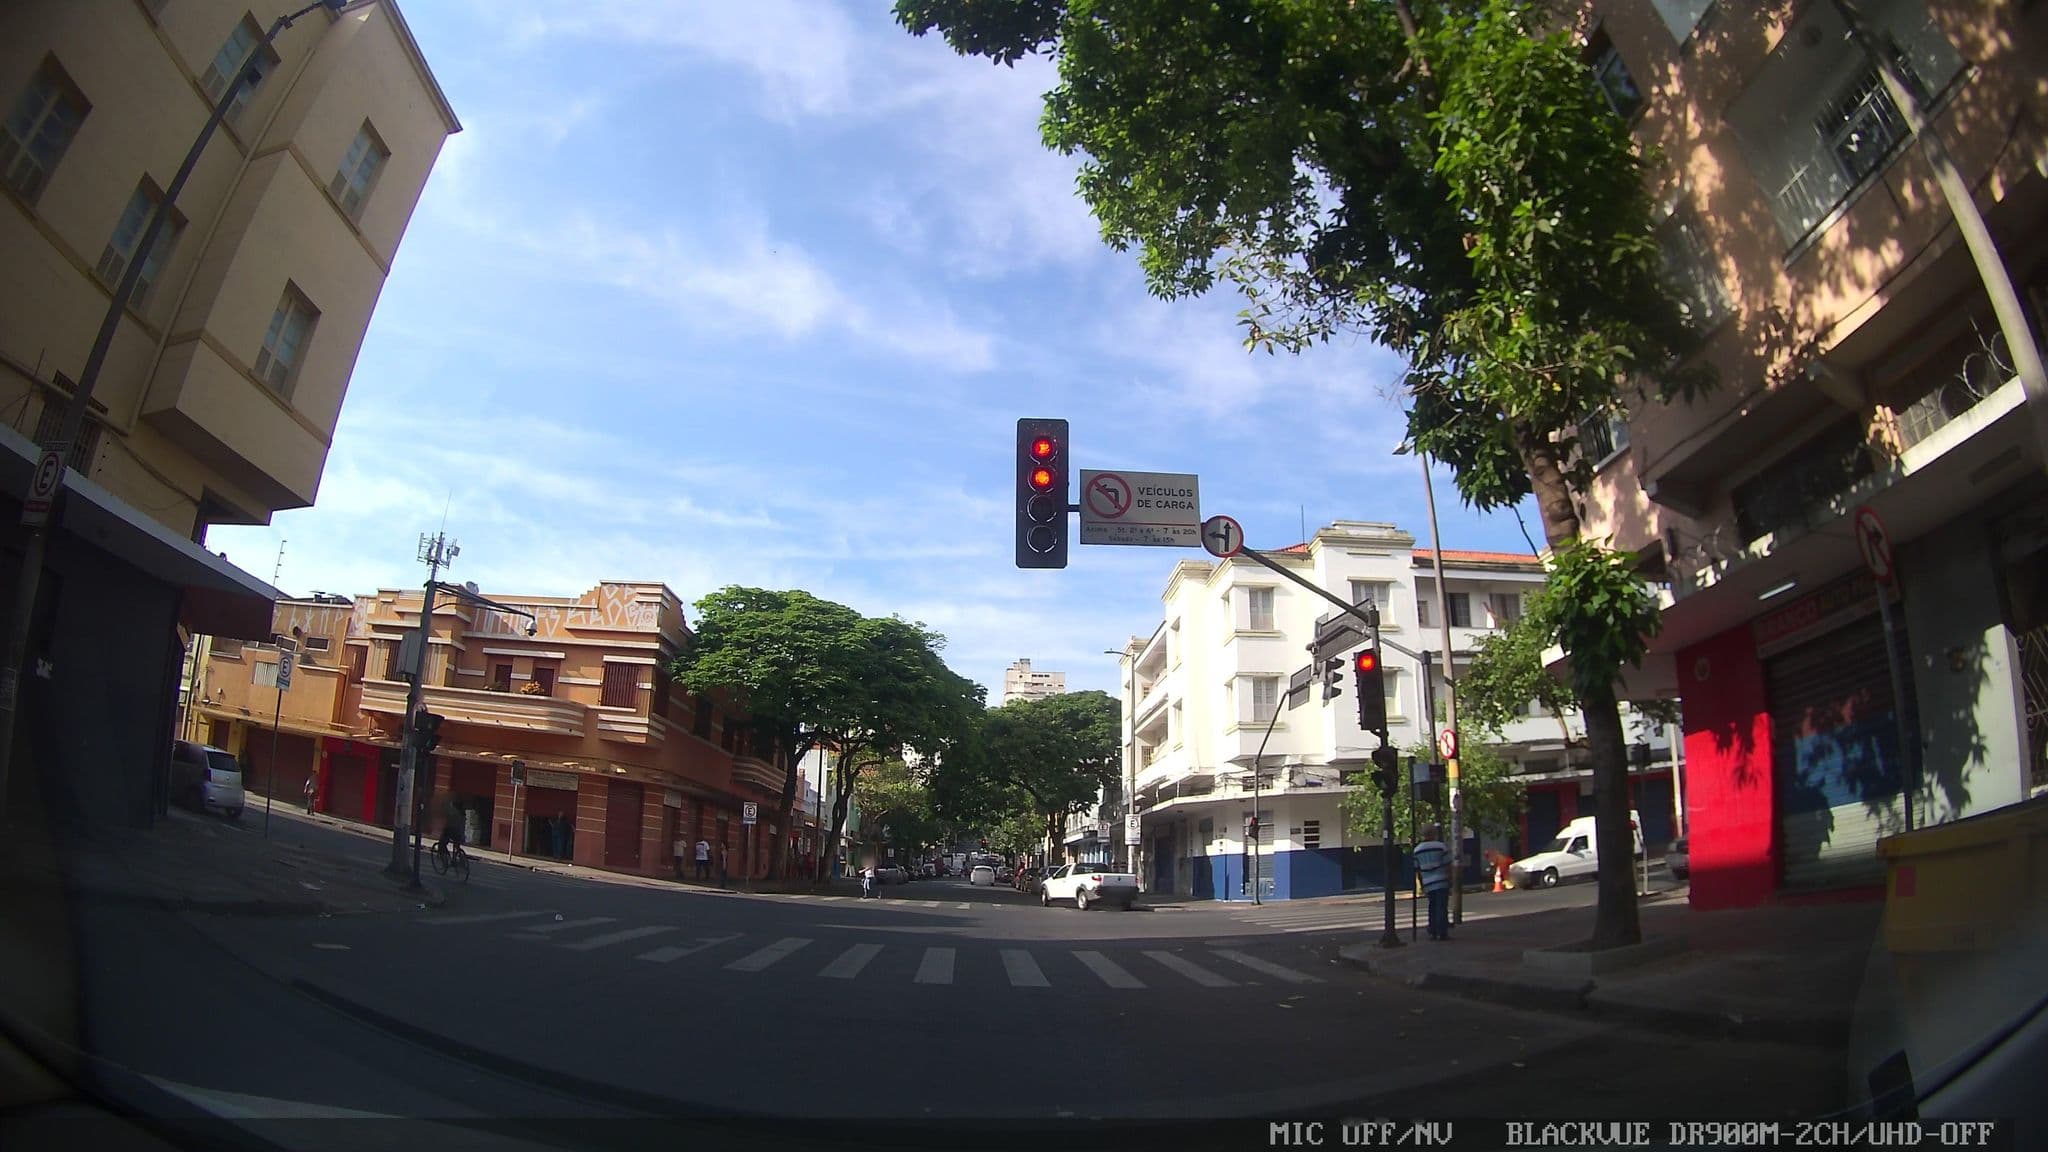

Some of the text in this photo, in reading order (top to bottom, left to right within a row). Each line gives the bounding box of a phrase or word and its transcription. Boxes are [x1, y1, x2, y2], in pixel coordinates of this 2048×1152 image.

[40, 460, 55, 489] E
[1137, 485, 1193, 497] VEÍCULOS
[1137, 500, 1194, 510] DE CARGA
